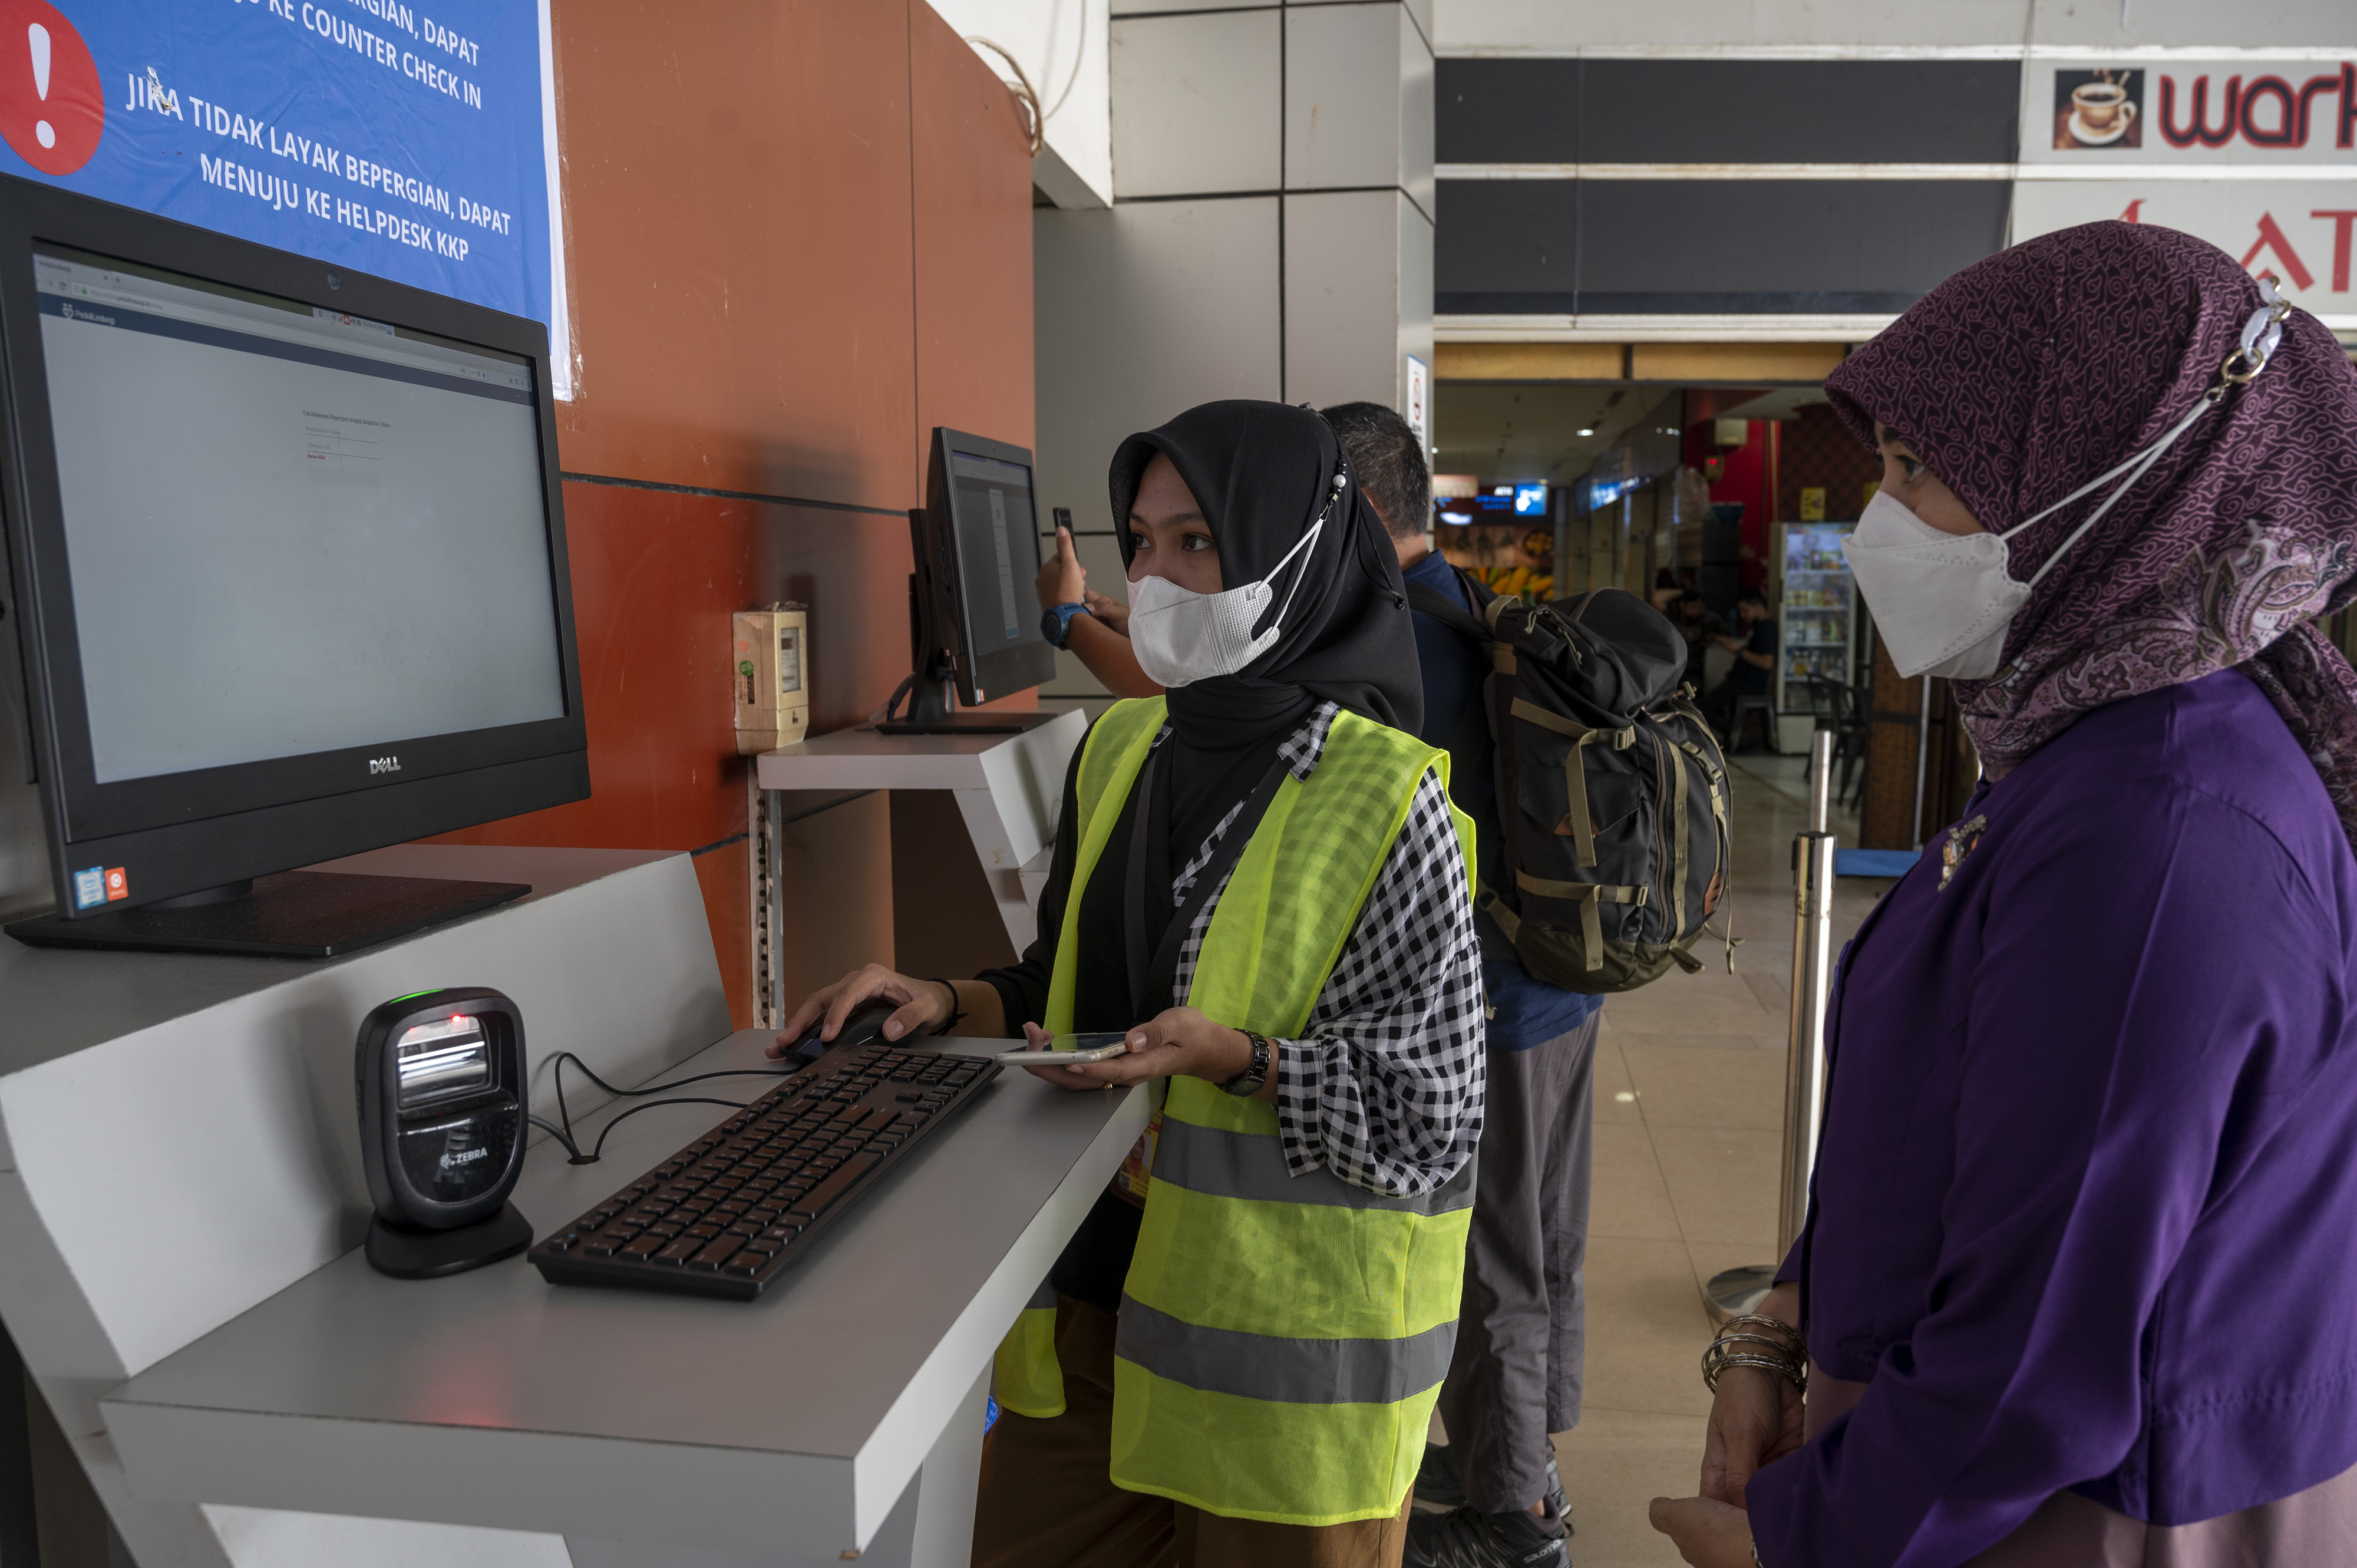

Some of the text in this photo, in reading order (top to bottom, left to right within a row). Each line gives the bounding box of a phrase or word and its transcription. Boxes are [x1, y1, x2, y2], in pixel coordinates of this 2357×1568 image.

[302, 2, 398, 71] COUNTER
[403, 52, 460, 100] CHECK
[463, 80, 481, 110] IN
[424, 17, 479, 67] DAPAT
[126, 72, 511, 236] JIKA TIDAK LAYAK BEPERGIAN, DAPAT
[200, 153, 469, 261] MENUJU KE HELPDESK KKP
[369, 756, 401, 774] DELL
[456, 1147, 488, 1164] ZEBRA
